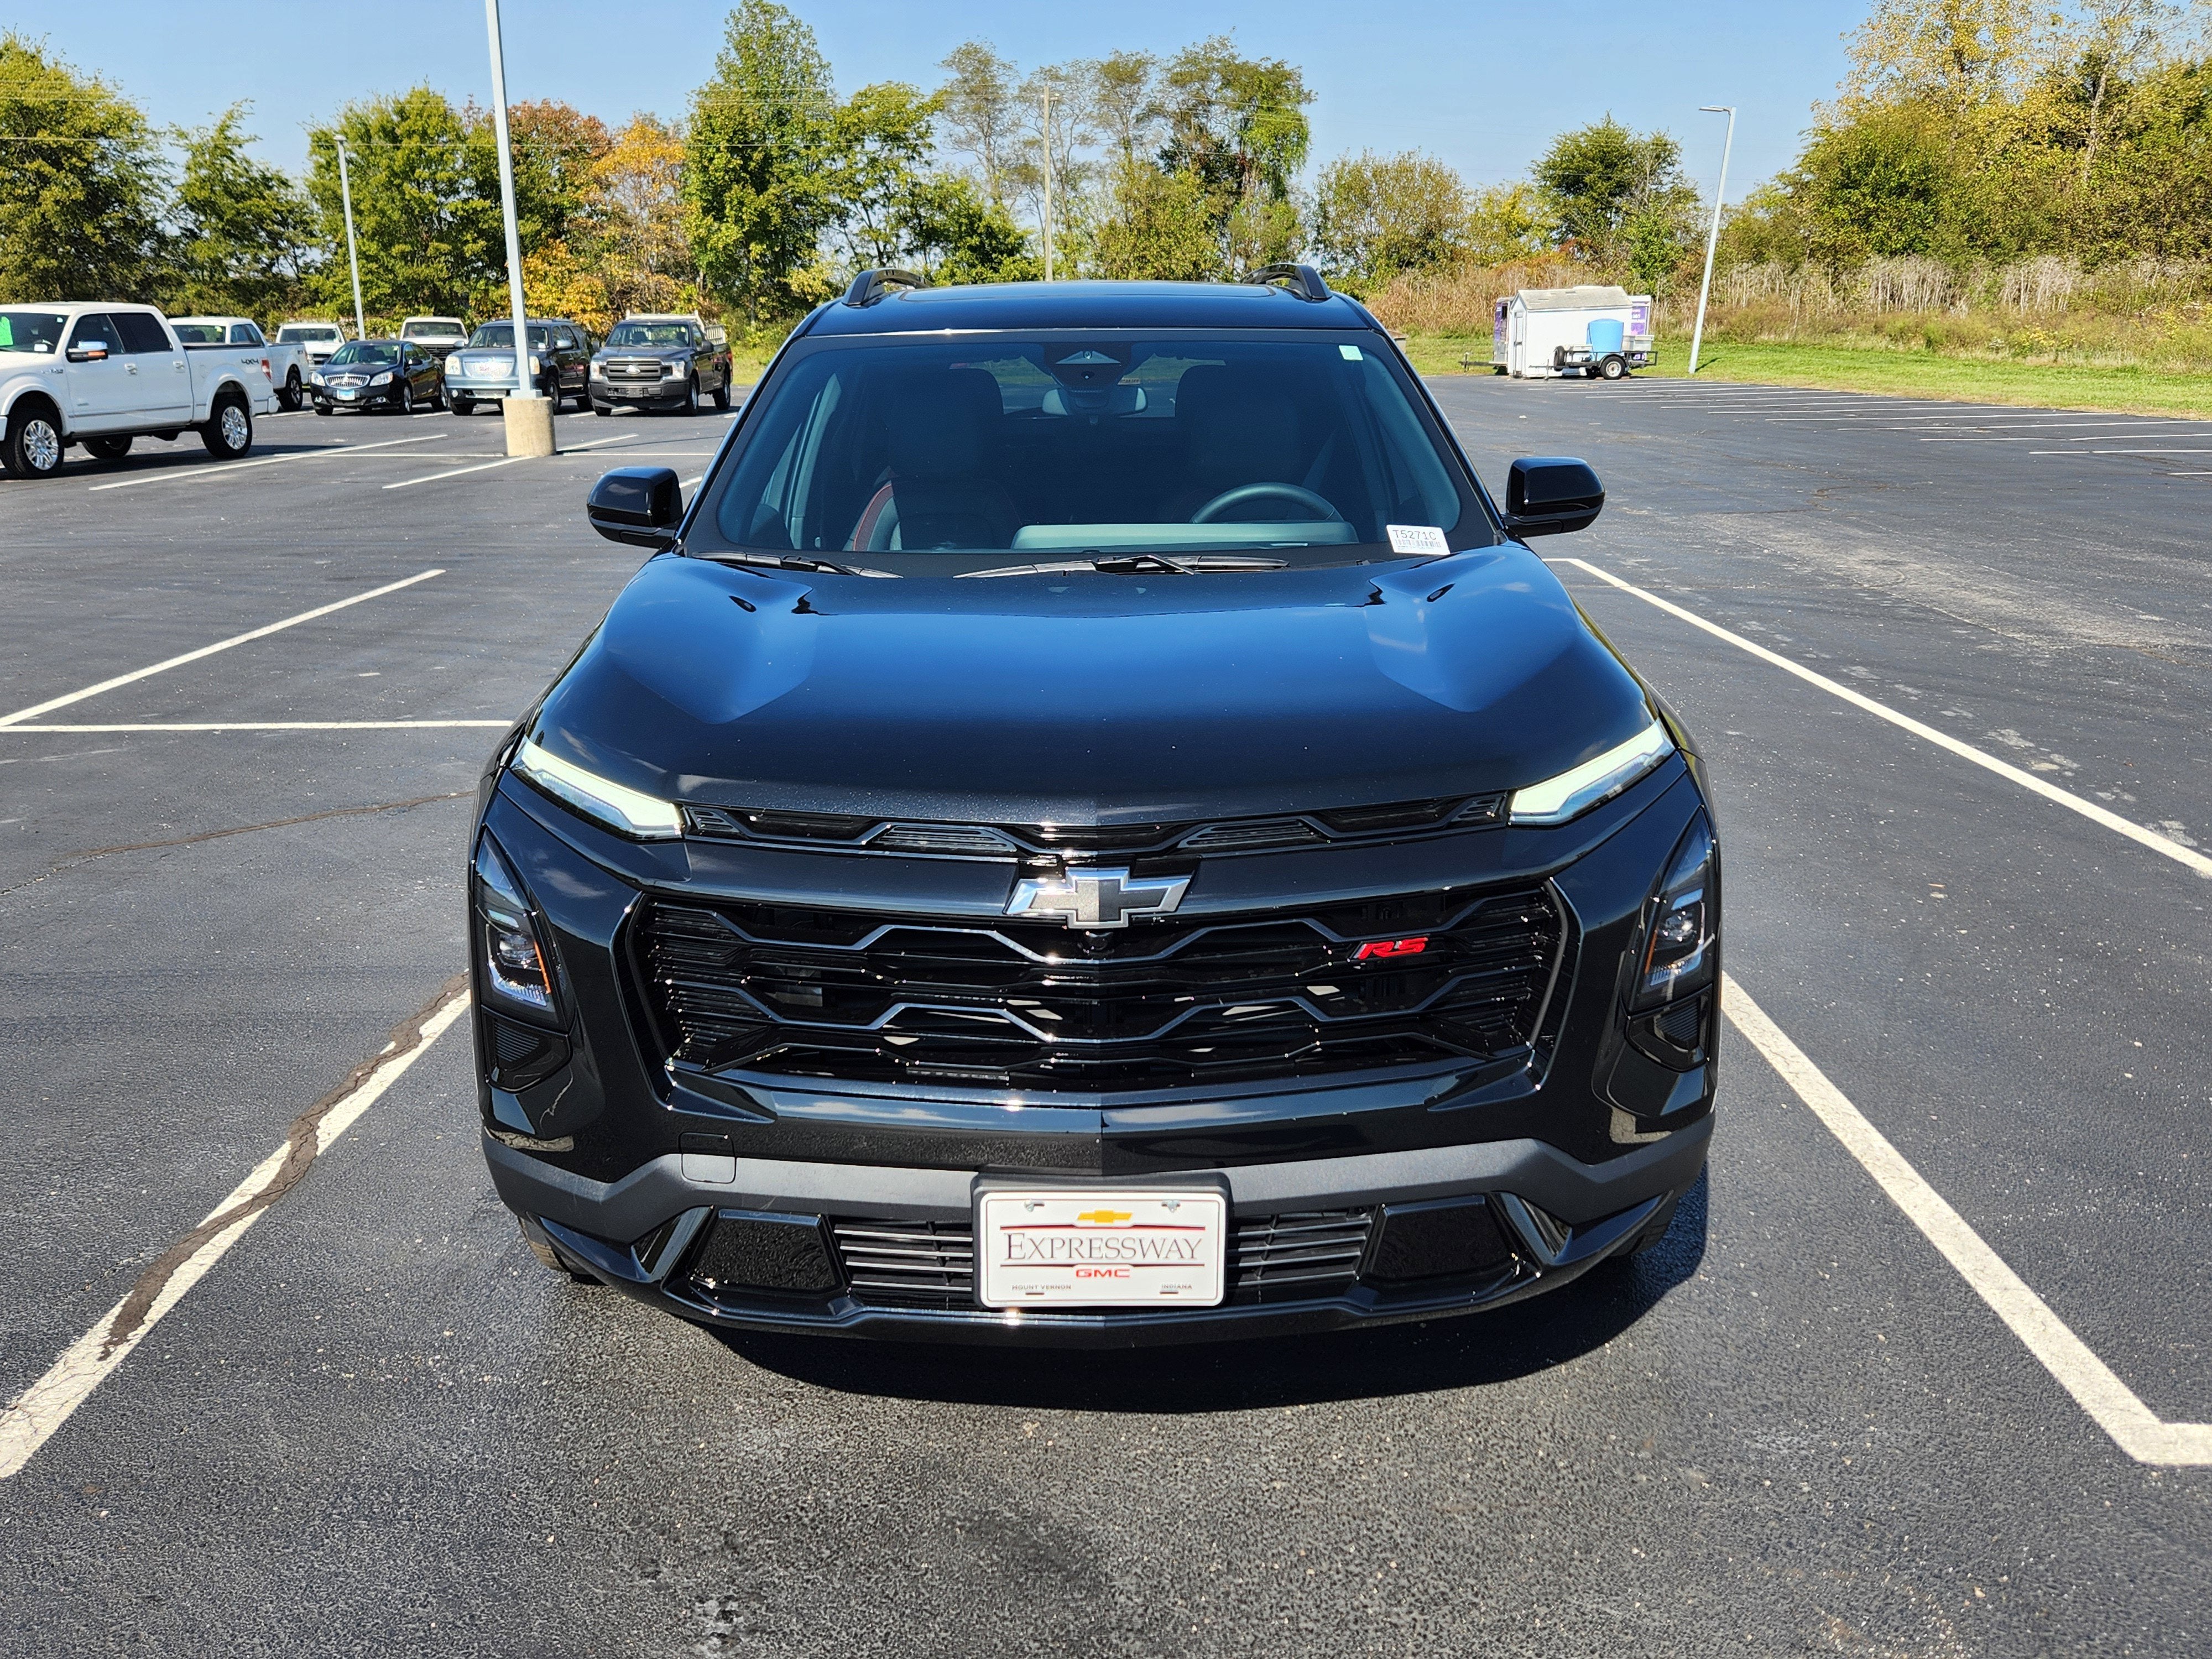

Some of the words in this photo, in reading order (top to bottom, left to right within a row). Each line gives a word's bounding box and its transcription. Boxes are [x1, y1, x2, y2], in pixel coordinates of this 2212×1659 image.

[1392, 530, 1437, 540] T5271C
[1354, 937, 1428, 959] RS
[1004, 1233, 1202, 1260] EXPRESSWAY
[1076, 1269, 1130, 1278] GMC
